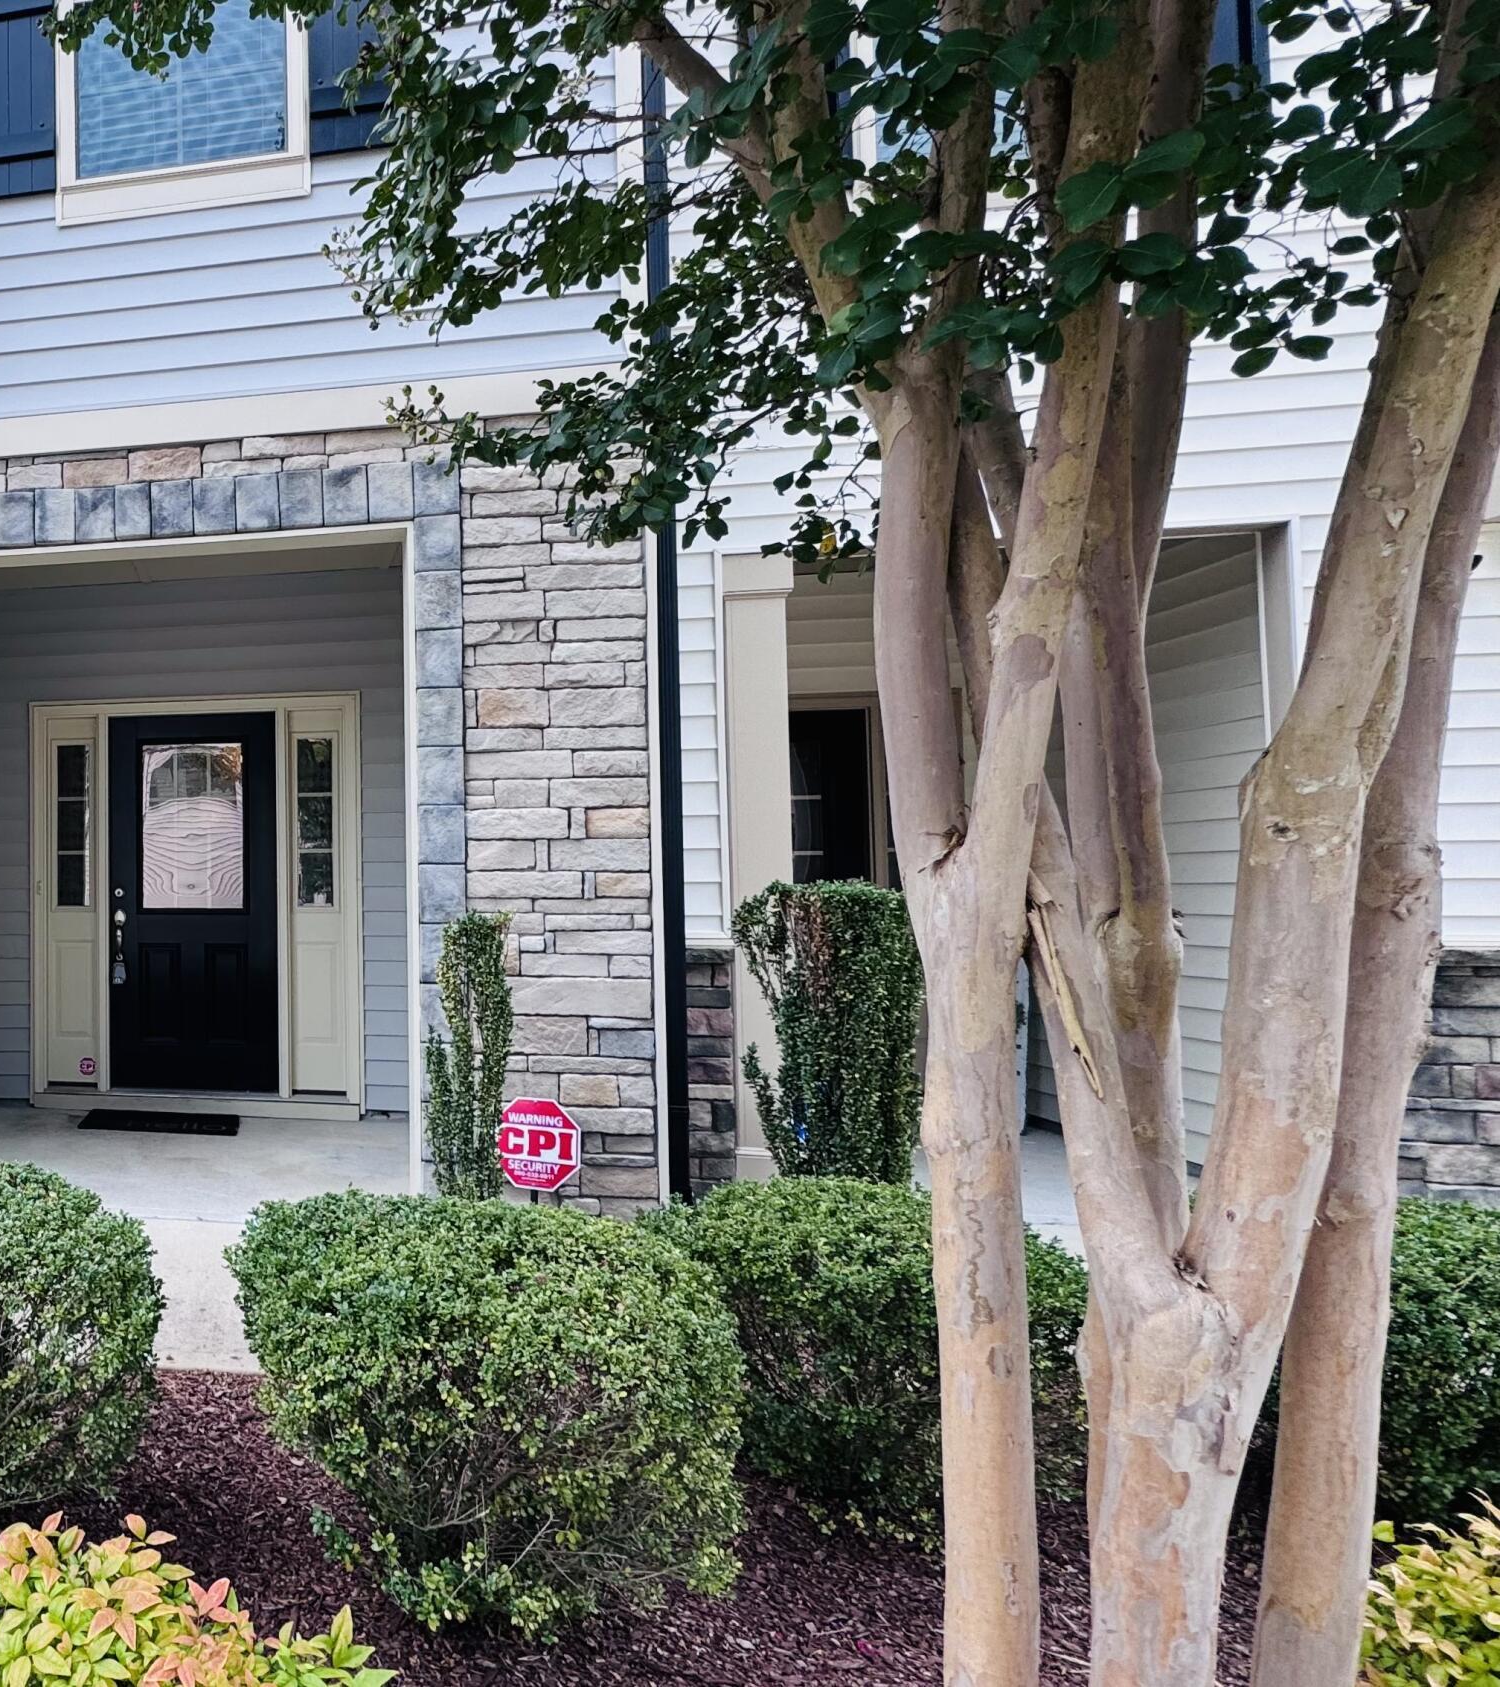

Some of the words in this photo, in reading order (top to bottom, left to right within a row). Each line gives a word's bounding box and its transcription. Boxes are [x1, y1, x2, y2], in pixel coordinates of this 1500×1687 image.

[507, 1112, 563, 1127] WARNING
[498, 1127, 573, 1160] CPI
[507, 1159, 561, 1174] SECURITY
